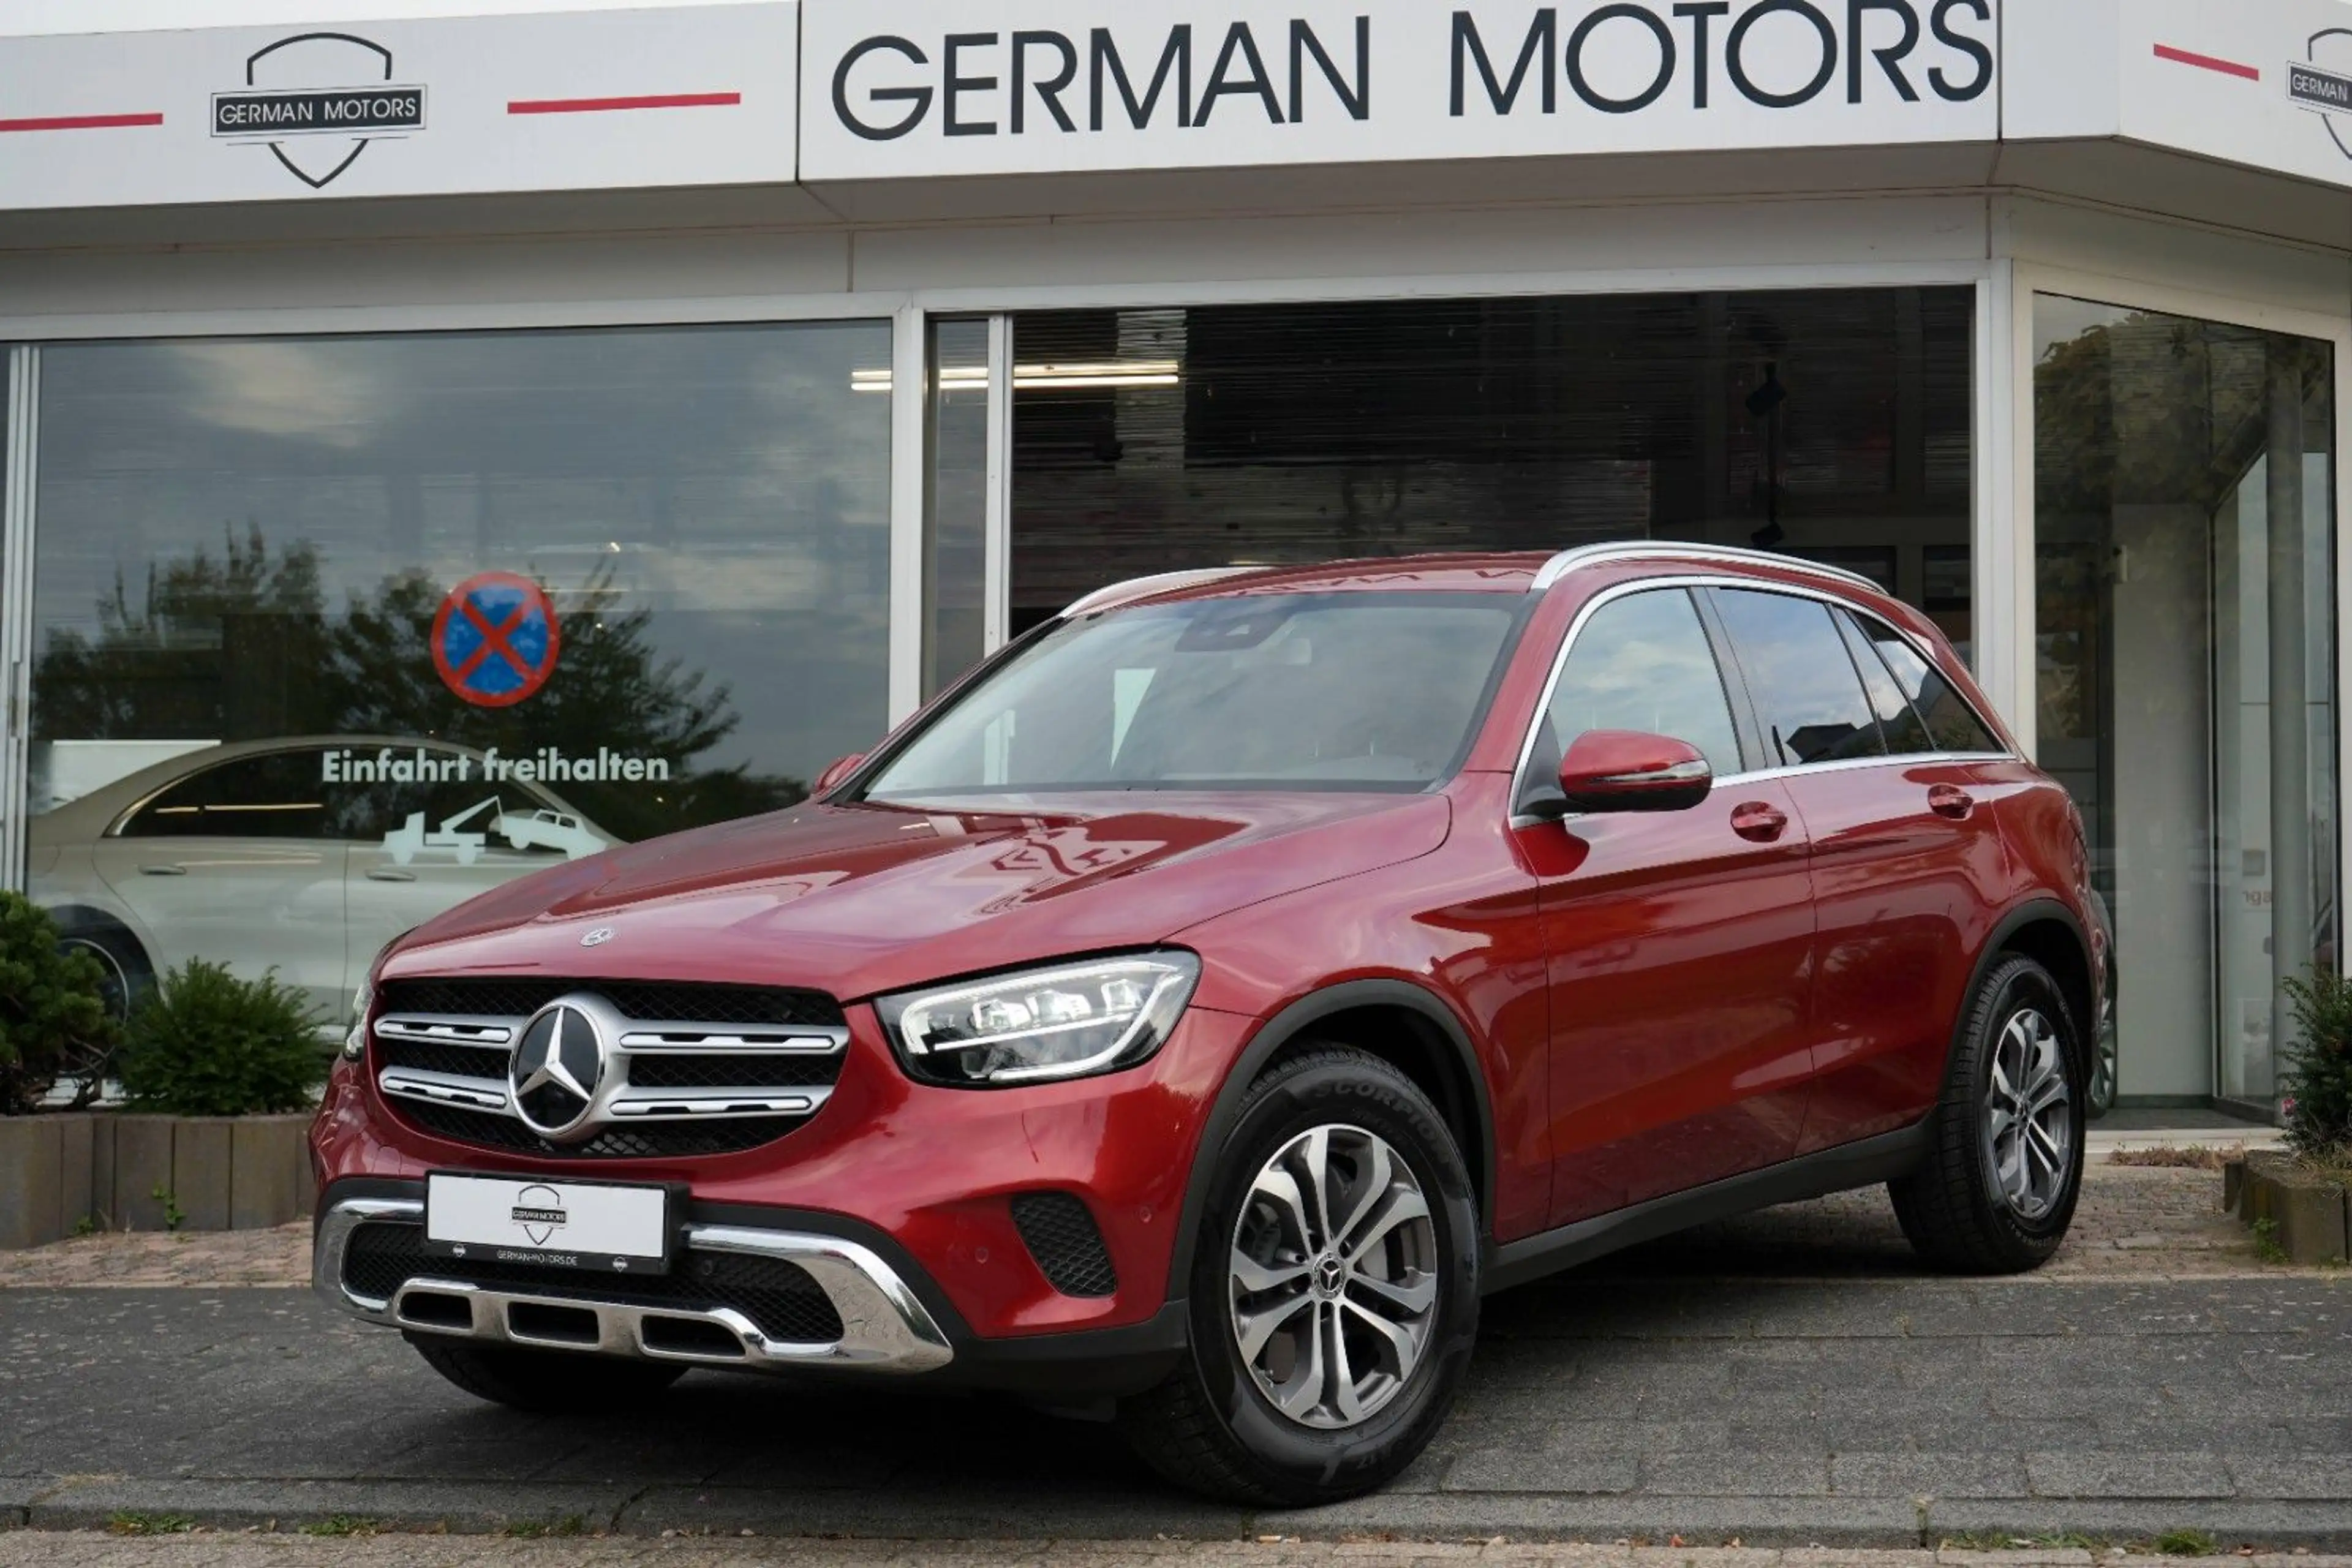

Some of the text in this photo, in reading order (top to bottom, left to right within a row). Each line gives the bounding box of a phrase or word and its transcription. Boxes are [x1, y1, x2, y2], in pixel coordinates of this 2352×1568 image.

[832, 0, 1993, 141] GERMAN MOTORS
[2292, 74, 2348, 102] GERMAN
[219, 97, 417, 124] GERMAN MOTORS
[322, 747, 669, 782] Einfahrt freihalten
